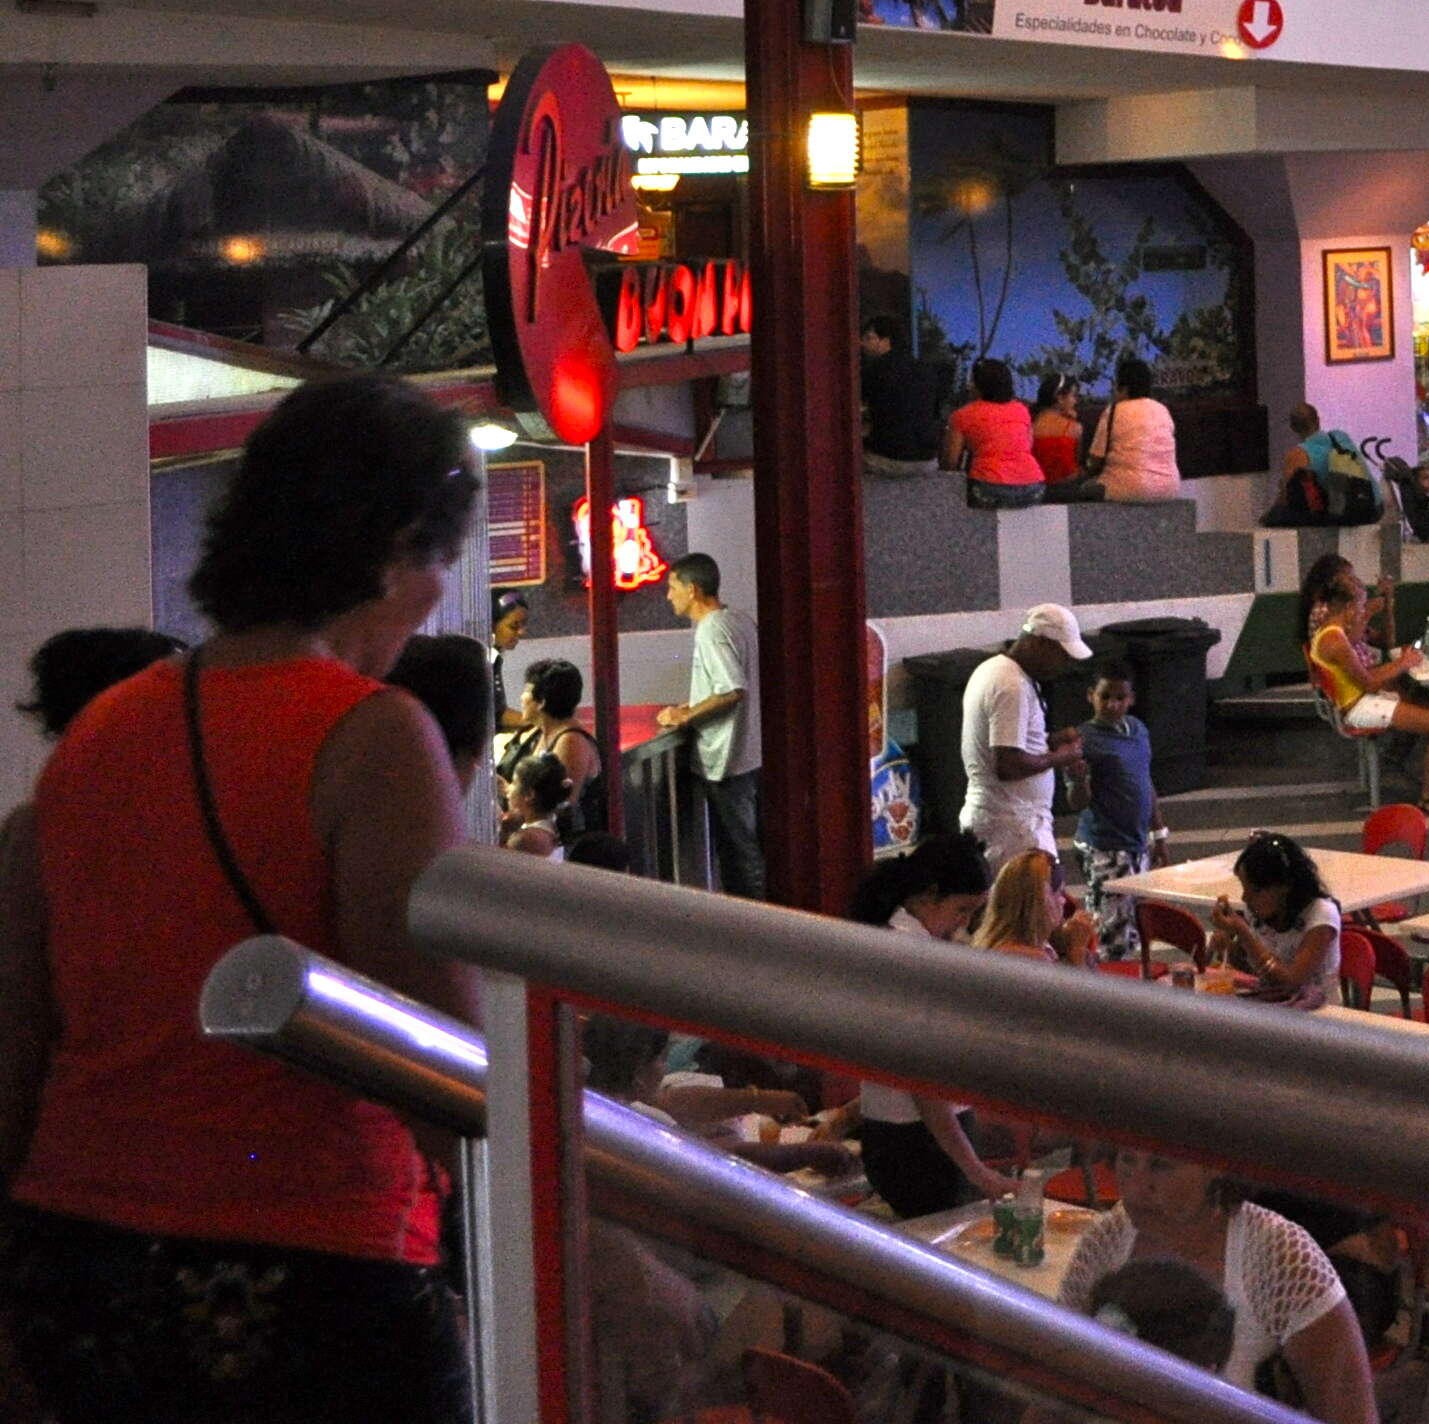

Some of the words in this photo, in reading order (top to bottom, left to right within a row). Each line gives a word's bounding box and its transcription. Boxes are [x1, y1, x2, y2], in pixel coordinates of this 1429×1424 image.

[1015, 12, 1112, 37] Especialidades
[1115, 26, 1131, 38] en
[1135, 24, 1196, 43] Chocolate
[1199, 33, 1206, 46] y
